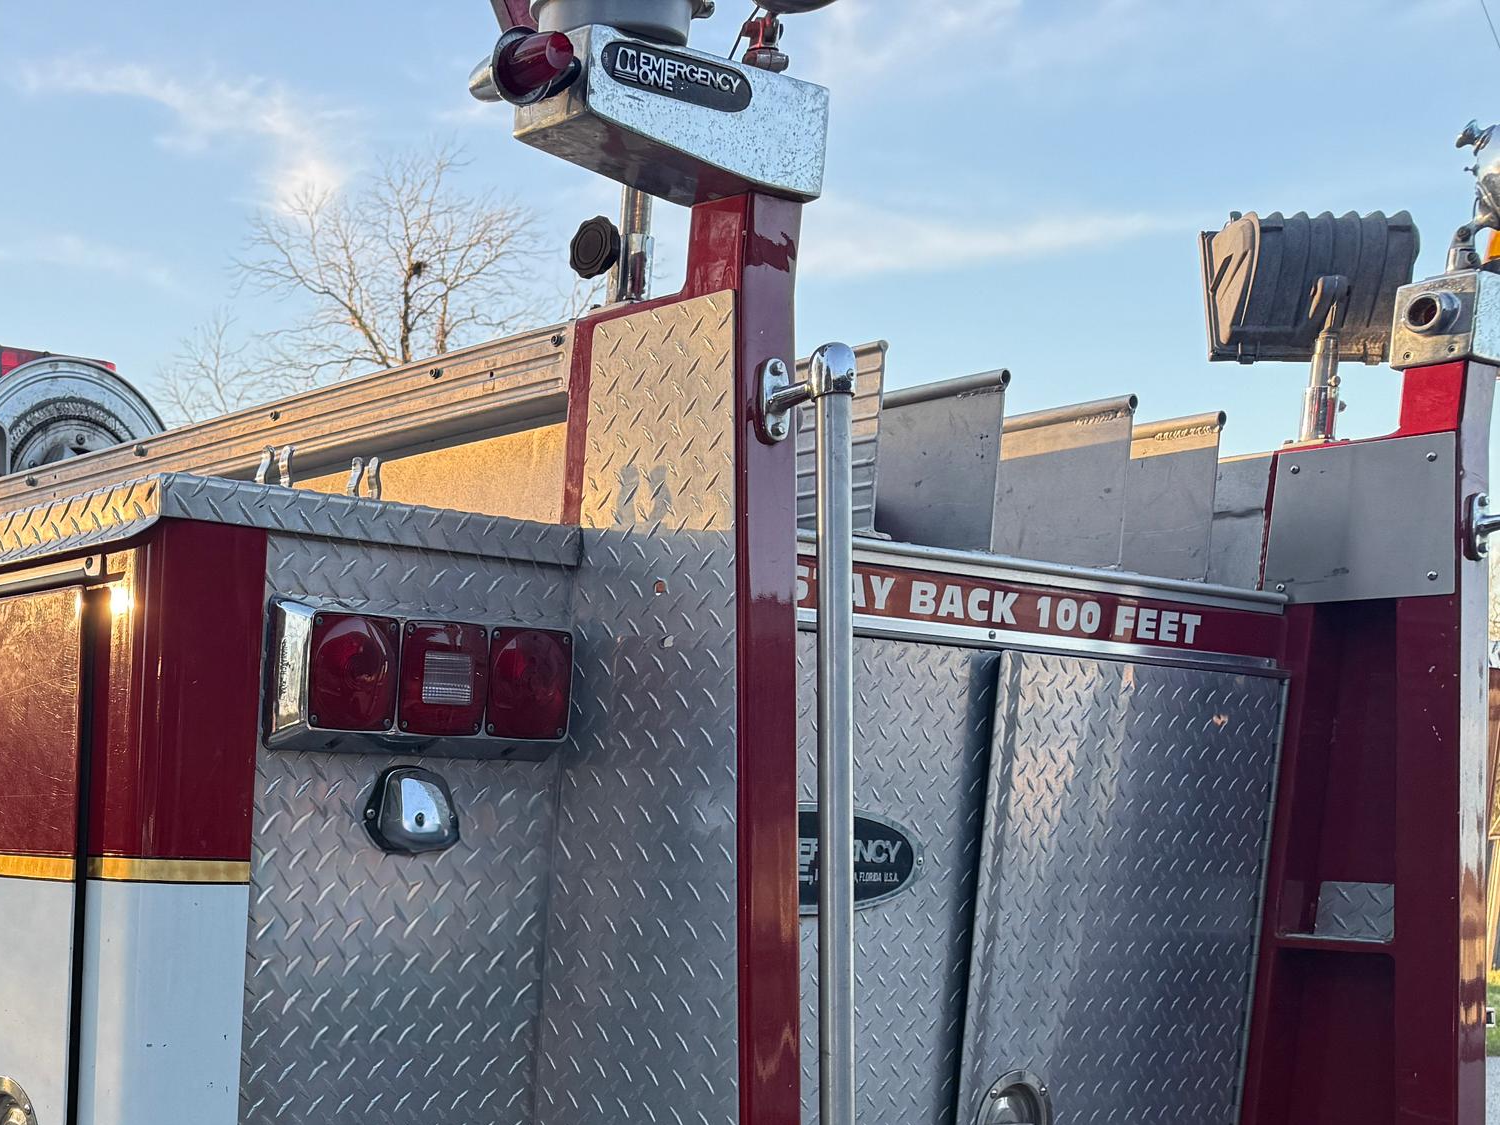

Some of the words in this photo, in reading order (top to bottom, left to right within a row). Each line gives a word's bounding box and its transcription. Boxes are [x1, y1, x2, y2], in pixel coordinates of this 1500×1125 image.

[638, 67, 674, 92] ONE
[639, 52, 742, 94] EMERGENCY
[796, 564, 896, 610] SAY
[909, 580, 1020, 625] BACK
[1036, 595, 1101, 634] 100
[1114, 605, 1202, 645] FEET
